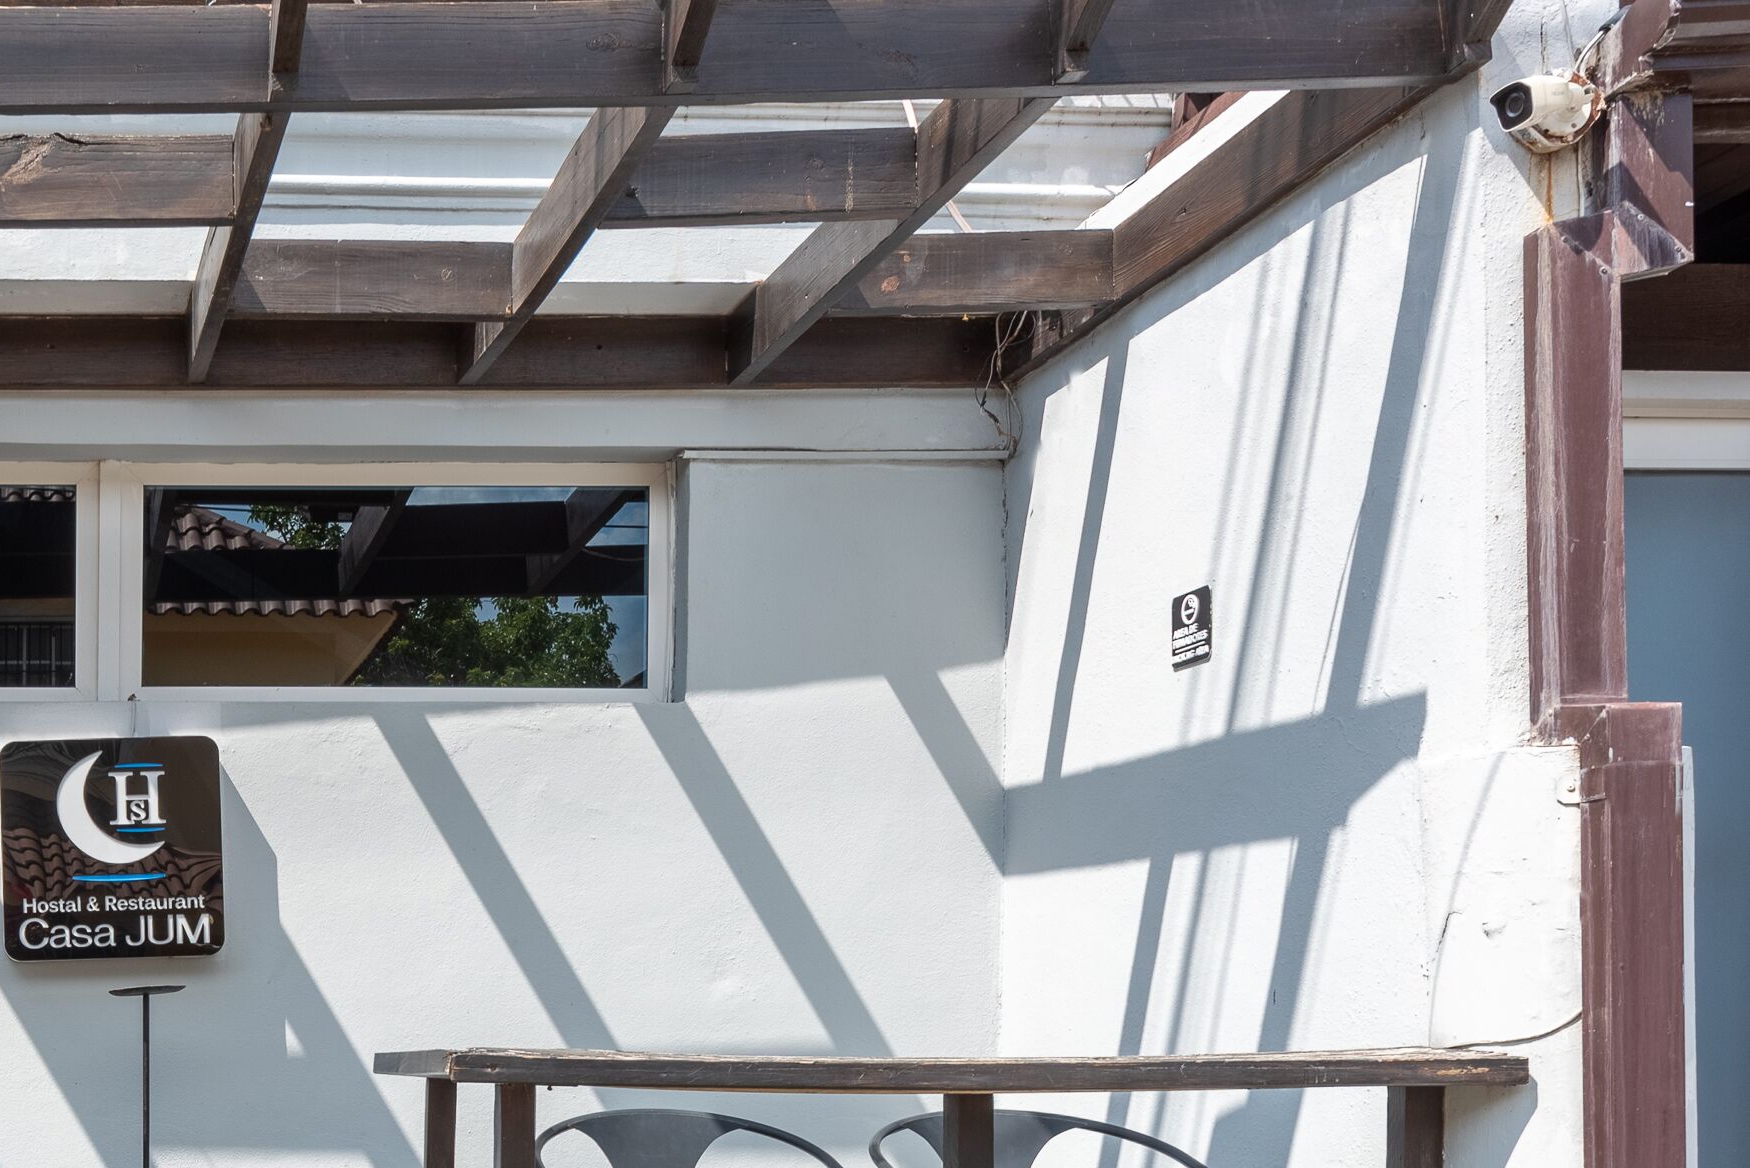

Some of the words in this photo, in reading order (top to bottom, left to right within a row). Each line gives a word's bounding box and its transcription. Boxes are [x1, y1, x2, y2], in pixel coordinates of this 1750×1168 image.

[22, 896, 82, 914] Hostal
[86, 896, 100, 912] &
[105, 894, 206, 911] Restaurant
[19, 917, 117, 950] Casa
[125, 913, 212, 947] JUM
